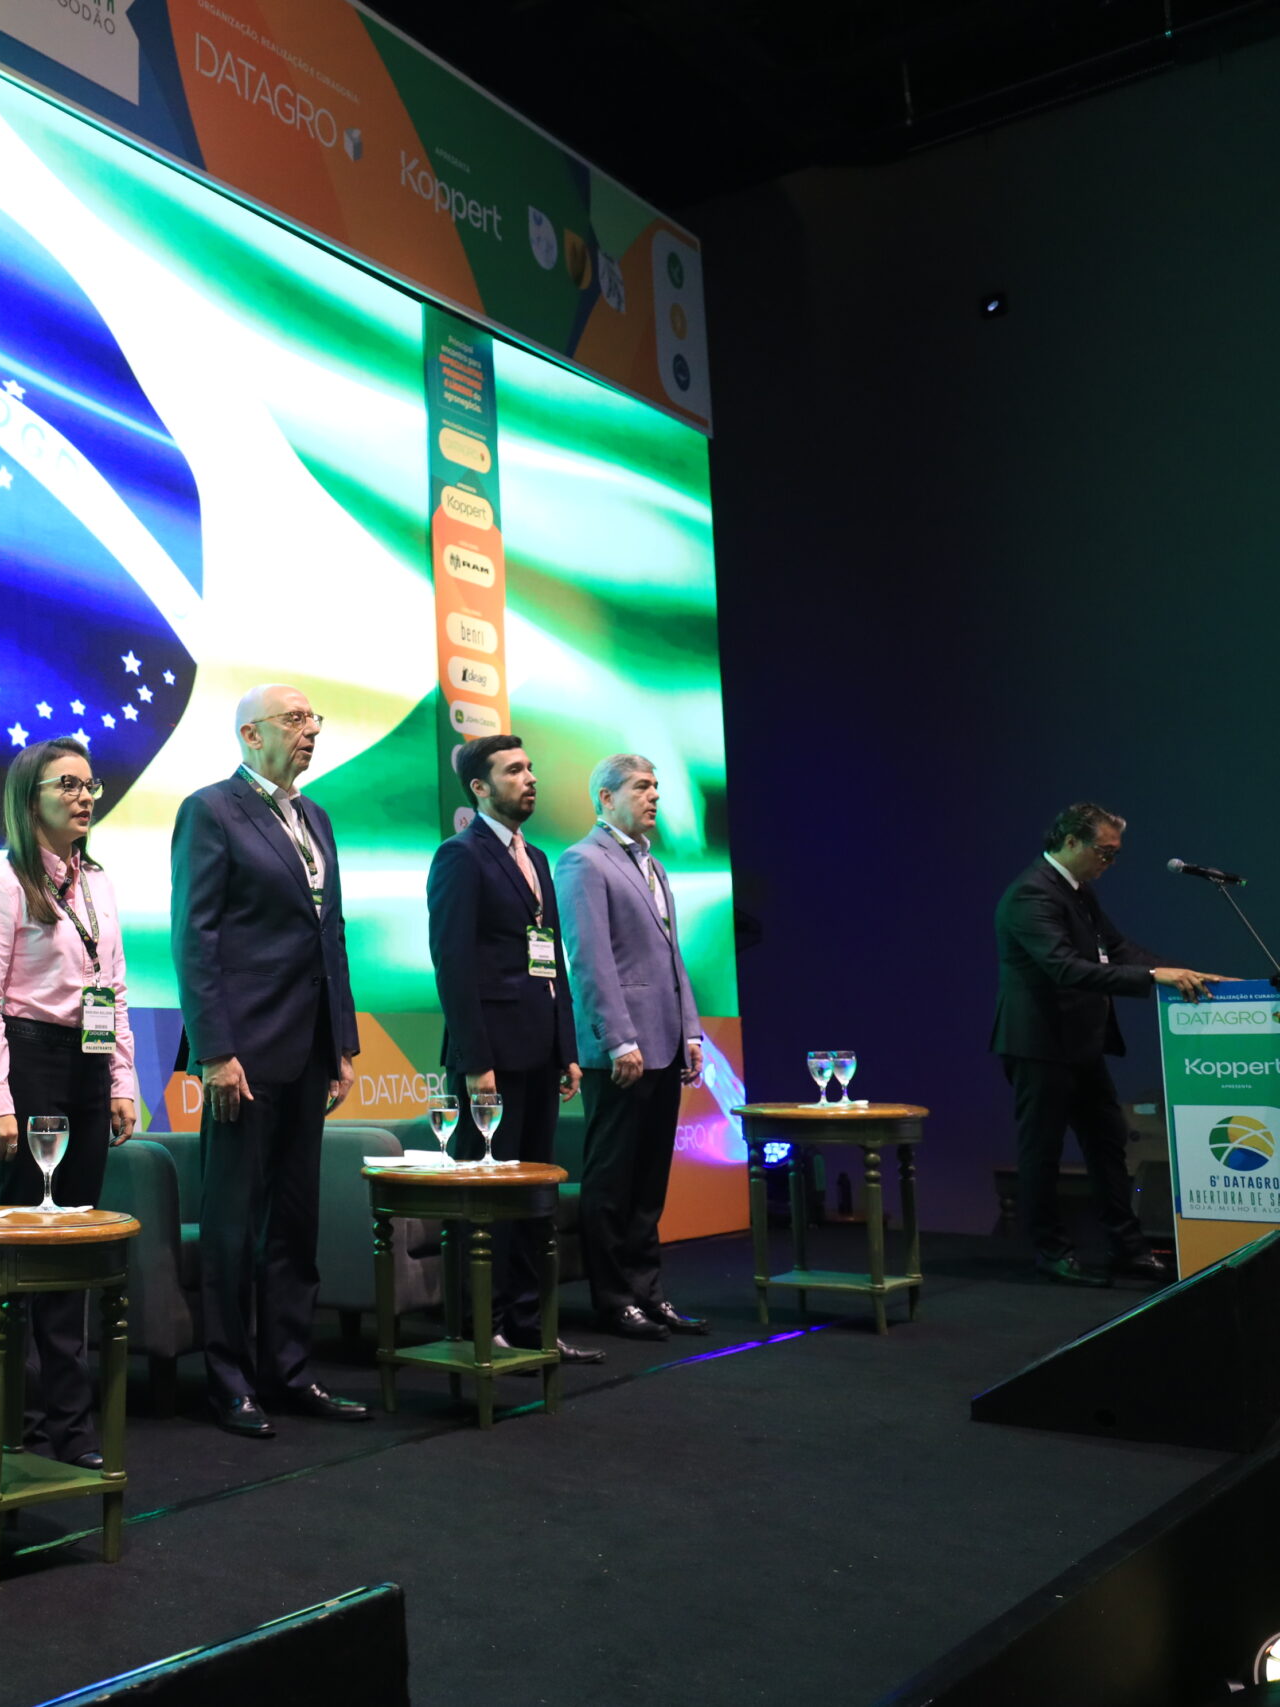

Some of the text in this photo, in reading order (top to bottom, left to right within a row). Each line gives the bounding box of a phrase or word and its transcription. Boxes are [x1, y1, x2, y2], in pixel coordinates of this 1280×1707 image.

[195, 32, 337, 148] DATAGRO
[401, 150, 502, 241] Koppert
[447, 493, 487, 520] Koppert
[462, 560, 490, 575] RAM
[1176, 1010, 1268, 1026] DATAGRO
[1184, 1058, 1280, 1078] Koppert
[1223, 1175, 1280, 1190] DATAGRO
[1189, 1190, 1243, 1206] ABERTURA
[1250, 1192, 1263, 1206] DE
